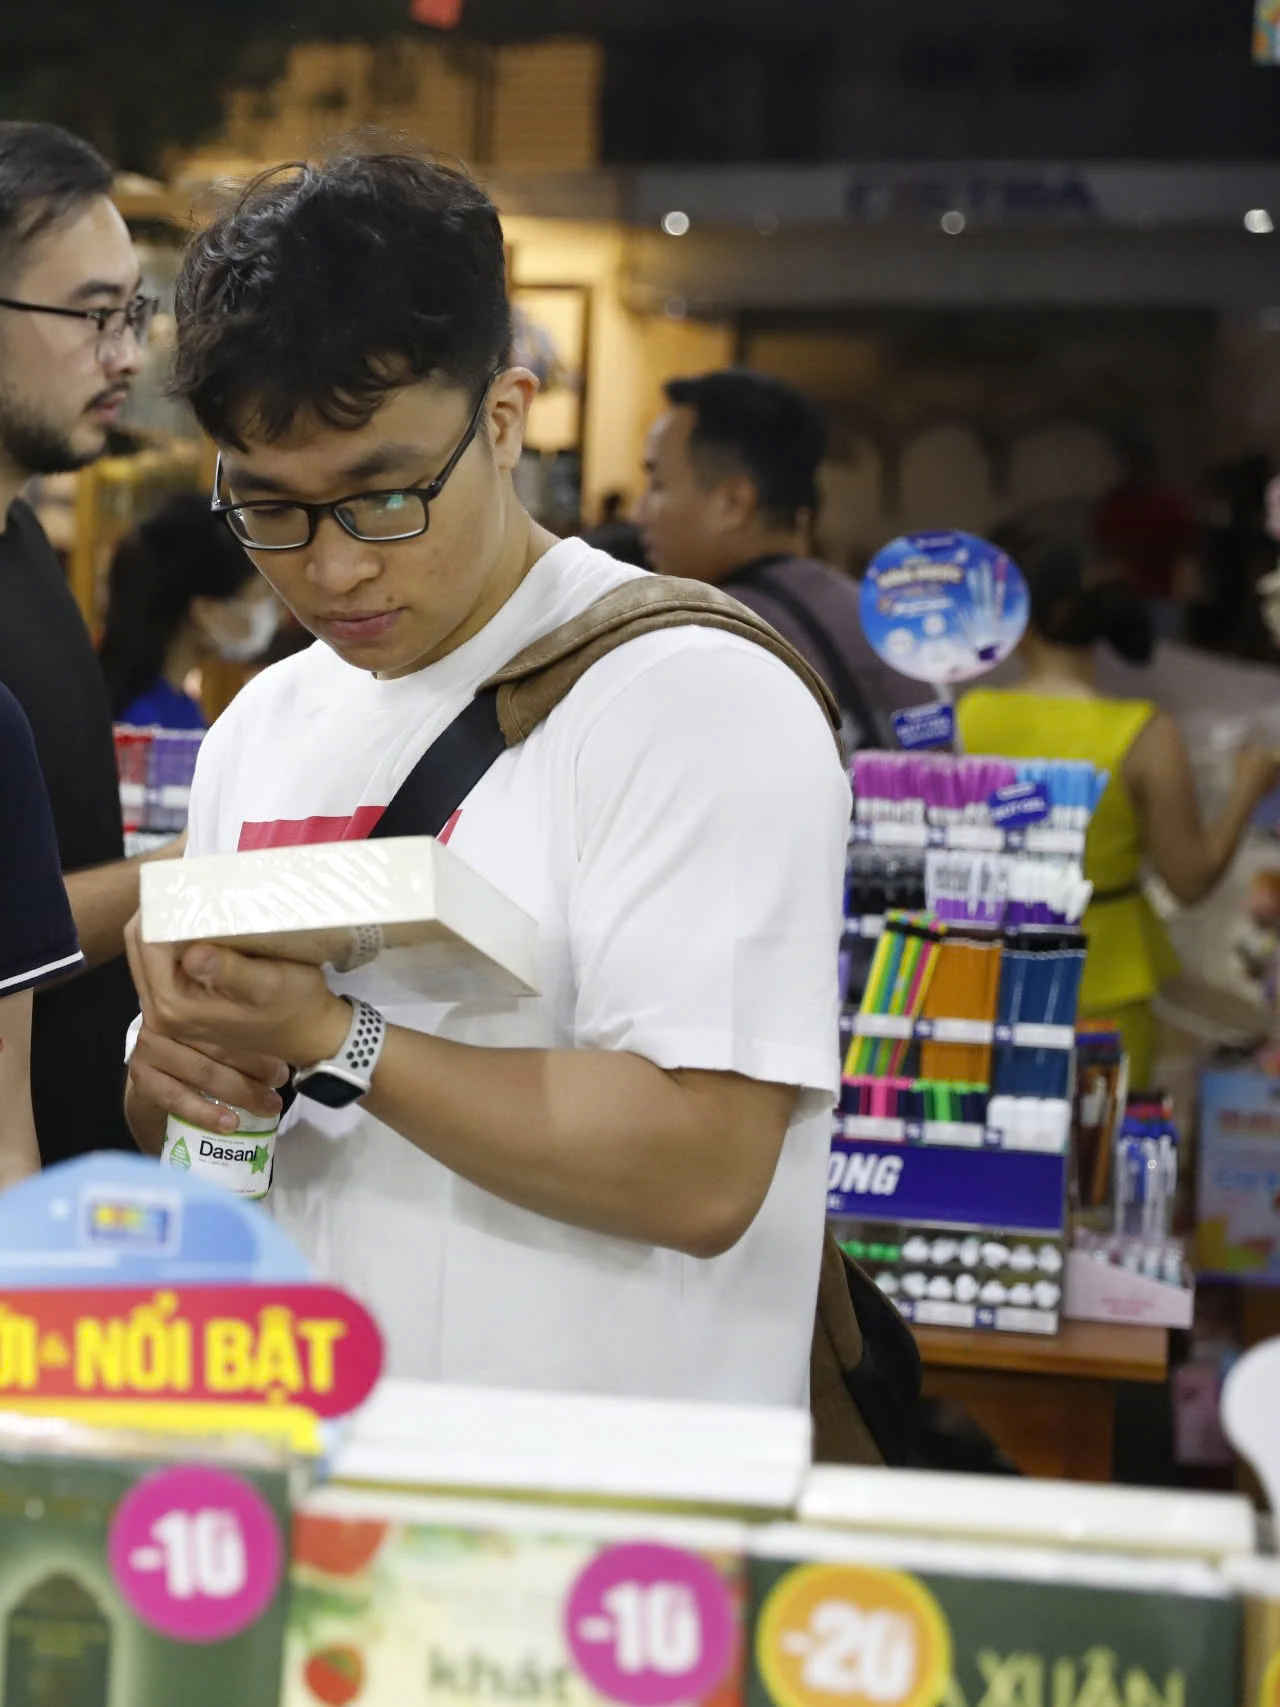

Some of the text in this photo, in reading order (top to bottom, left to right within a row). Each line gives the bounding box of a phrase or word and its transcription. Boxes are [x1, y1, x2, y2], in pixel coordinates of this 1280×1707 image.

[199, 1139, 259, 1163] Dasani
[74, 1289, 192, 1391] NỔI
[204, 1304, 346, 1406] BẬT
[127, 1508, 249, 1600] -10
[576, 1578, 703, 1677] -10
[780, 1599, 918, 1703] -20
